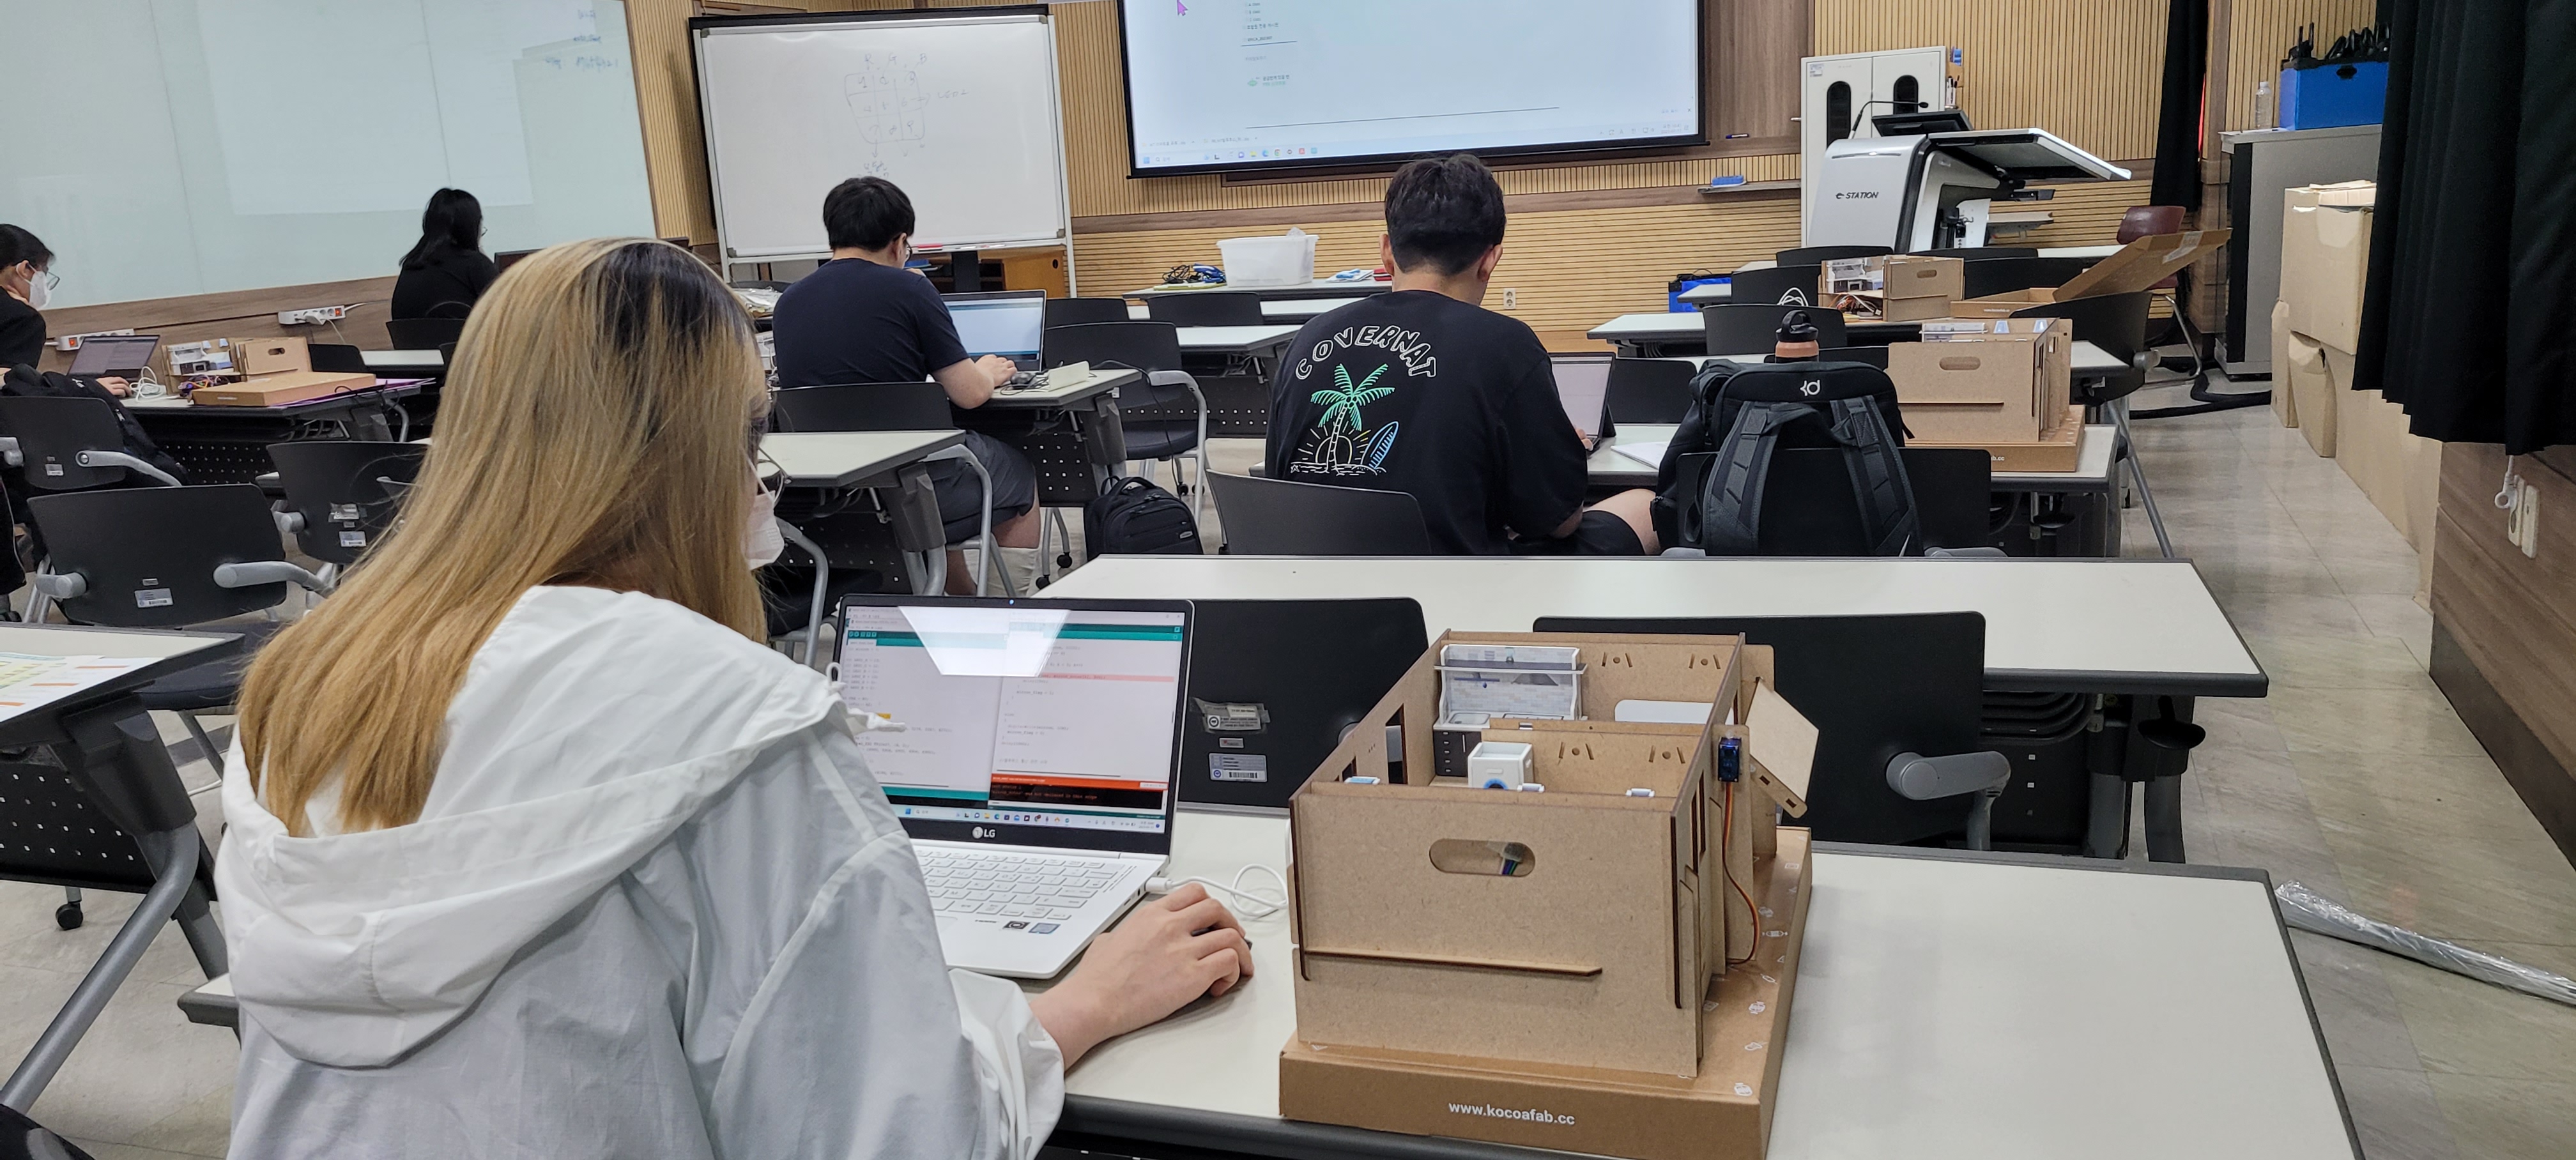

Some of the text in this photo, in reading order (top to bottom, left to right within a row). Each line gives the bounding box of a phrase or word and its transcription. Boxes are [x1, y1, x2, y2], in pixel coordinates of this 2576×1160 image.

[1296, 325, 1437, 379] COVERNAT
[984, 828, 996, 838] LG
[1448, 1103, 1575, 1126] www.kocoafab.cc
